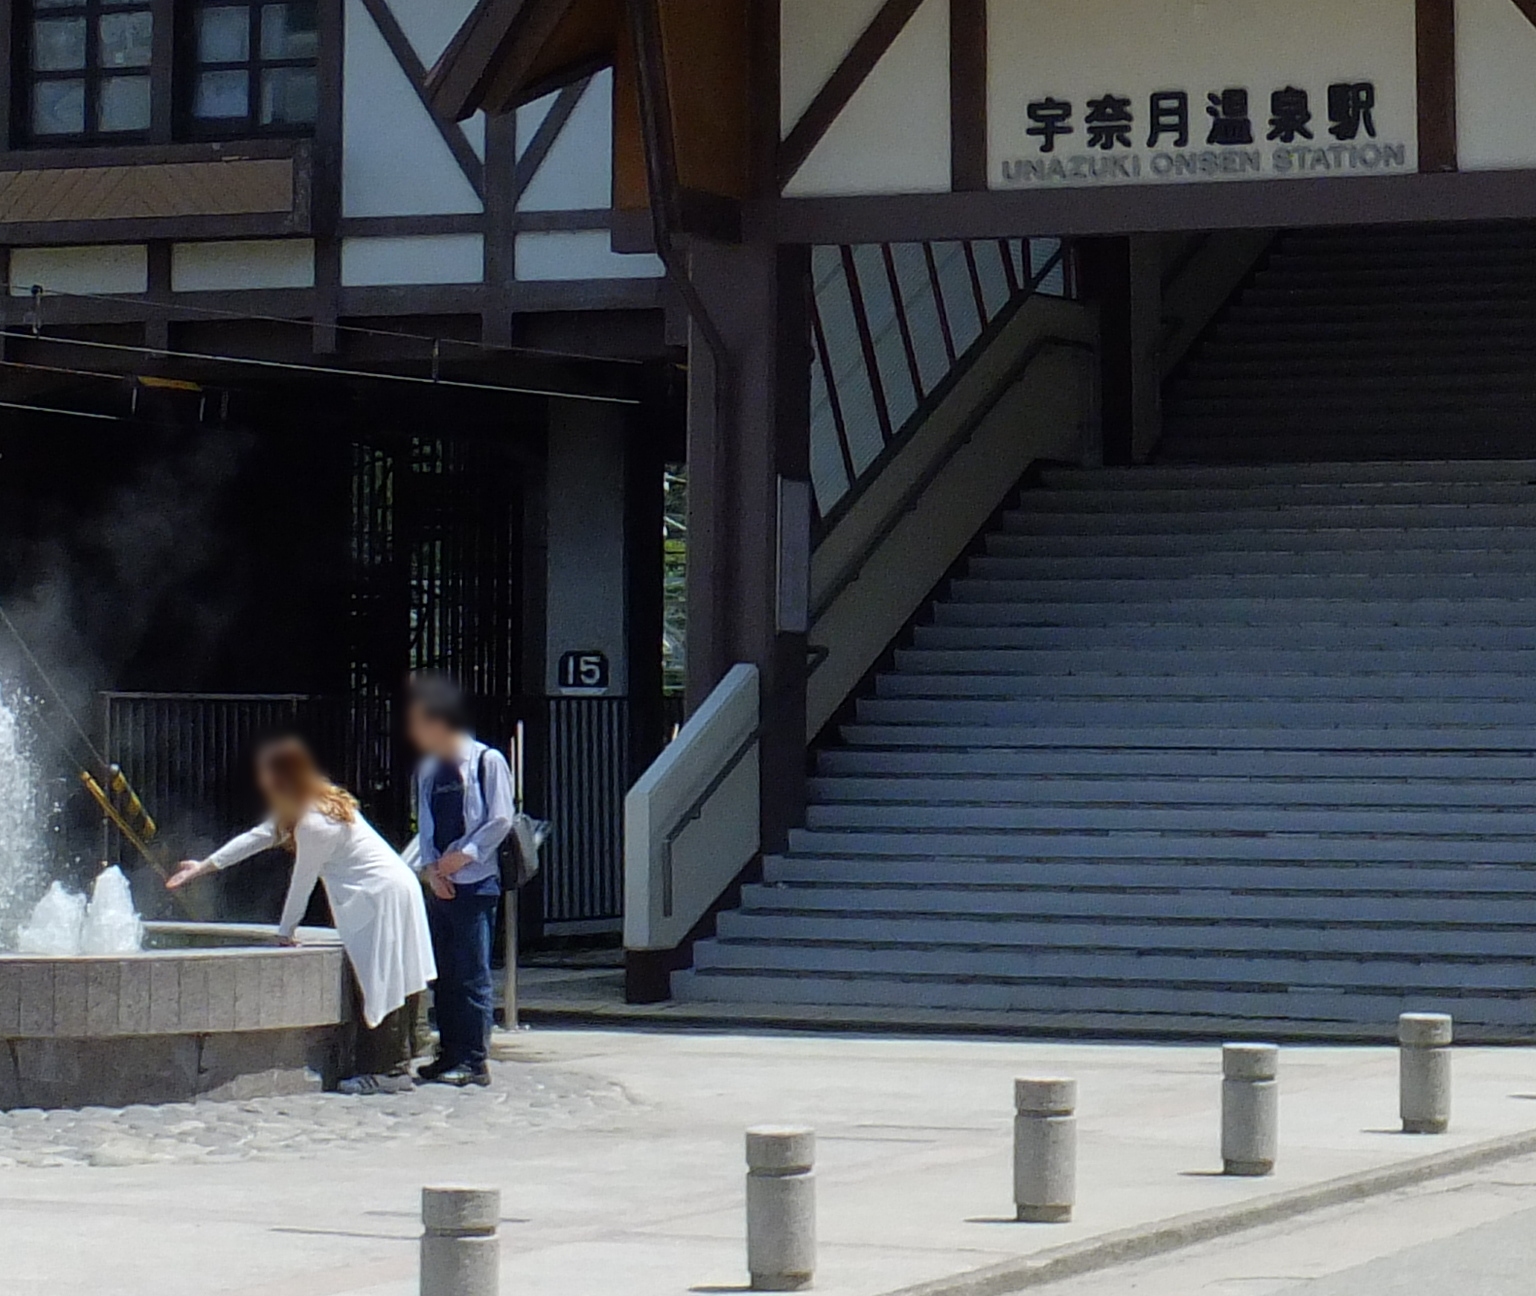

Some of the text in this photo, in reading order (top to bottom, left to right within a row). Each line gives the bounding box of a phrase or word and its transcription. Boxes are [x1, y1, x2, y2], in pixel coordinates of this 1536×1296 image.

[1025, 82, 1376, 152] 宇奈月温泉駅
[1001, 142, 1406, 182] UNAZUKI ONSEN STATION
[567, 655, 601, 685] 15
